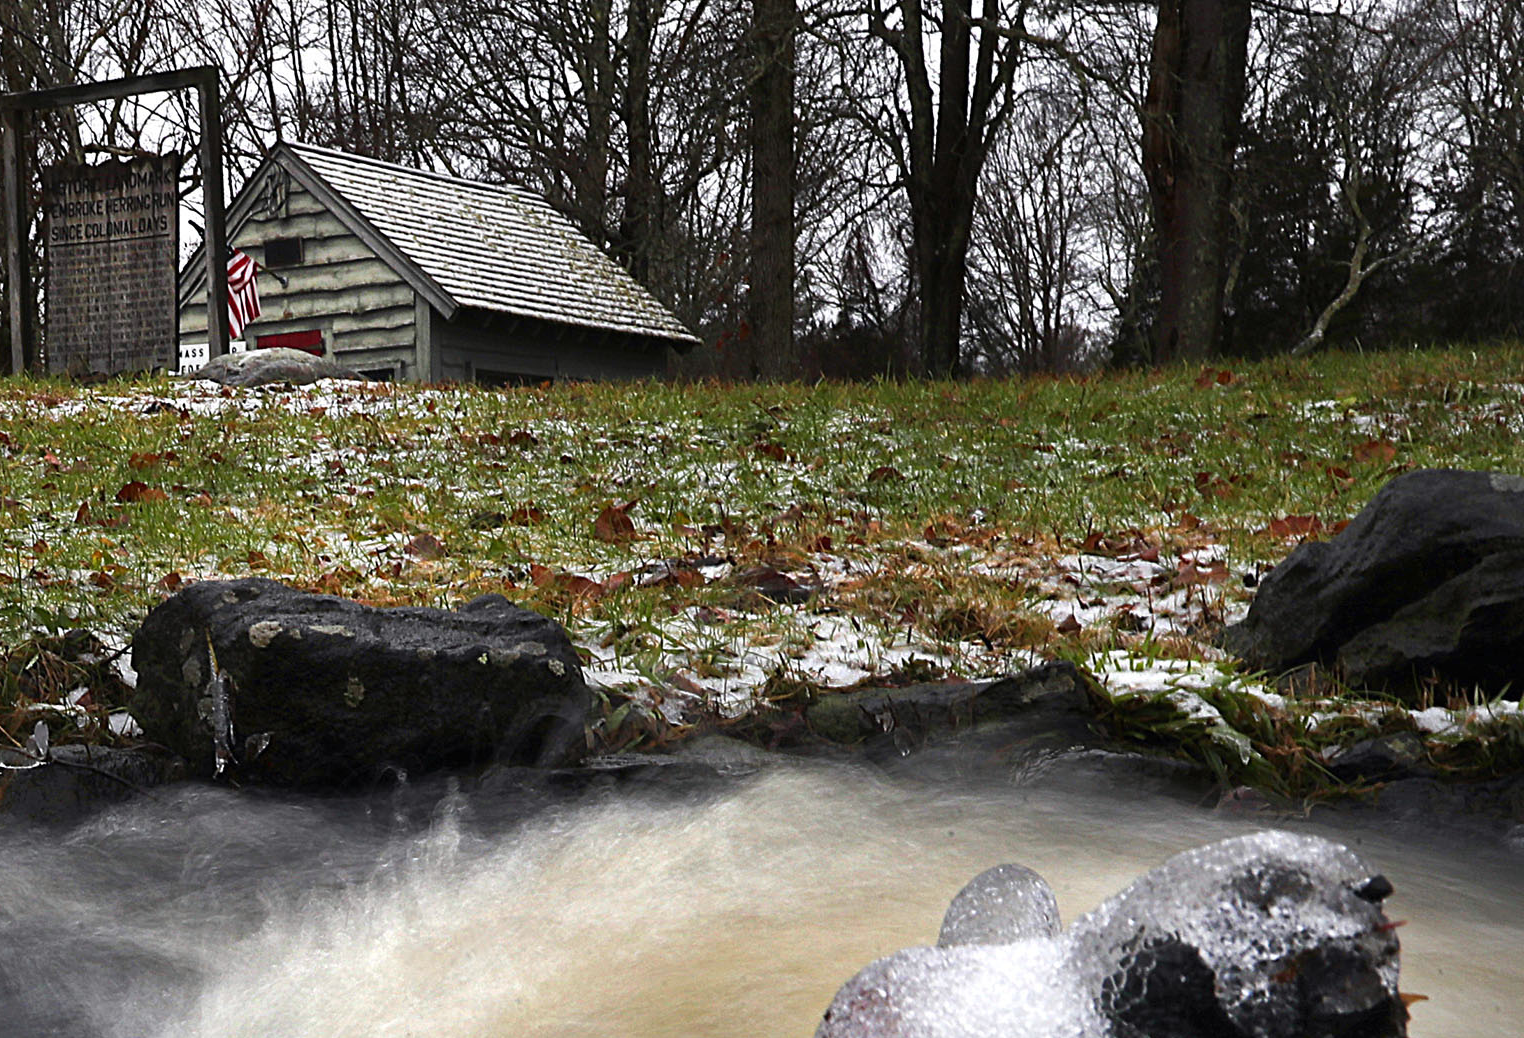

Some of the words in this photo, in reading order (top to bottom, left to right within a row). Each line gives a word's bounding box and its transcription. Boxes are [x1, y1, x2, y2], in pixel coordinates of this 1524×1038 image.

[46, 177, 101, 197] STORIC
[44, 199, 104, 219] EMBROKE
[106, 195, 151, 214] HERRING
[152, 192, 175, 208] RUN
[51, 224, 83, 242] SINCE
[85, 219, 137, 238] COLONIAL
[138, 215, 168, 233] DAYS
